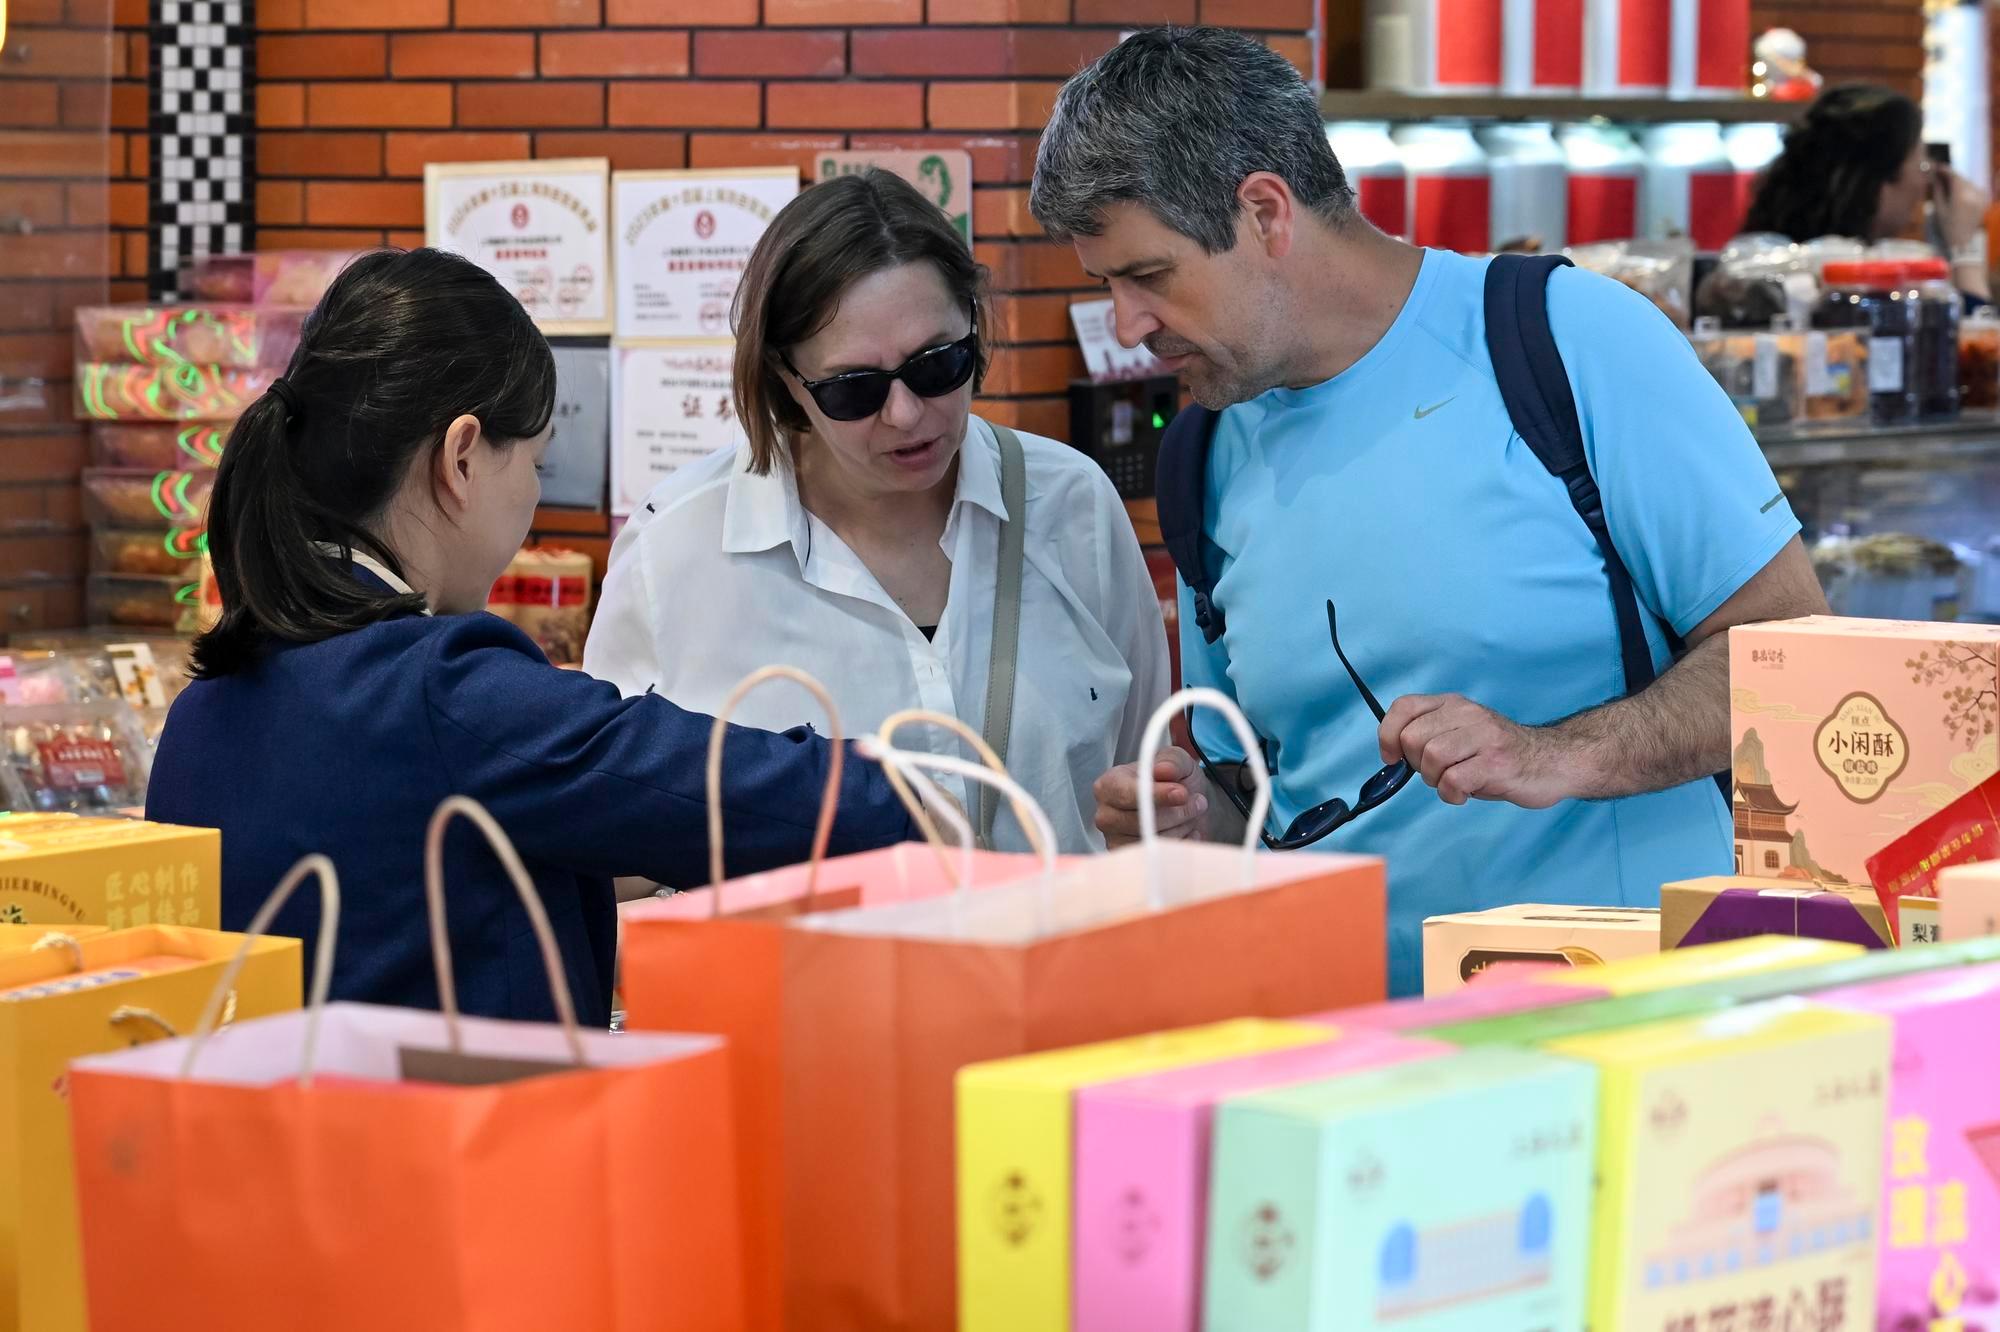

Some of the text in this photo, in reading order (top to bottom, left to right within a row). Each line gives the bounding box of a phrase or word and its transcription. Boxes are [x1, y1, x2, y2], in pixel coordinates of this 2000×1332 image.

[1828, 730, 1894, 757] 小闲酥
[105, 862, 200, 902] 匠心制作
